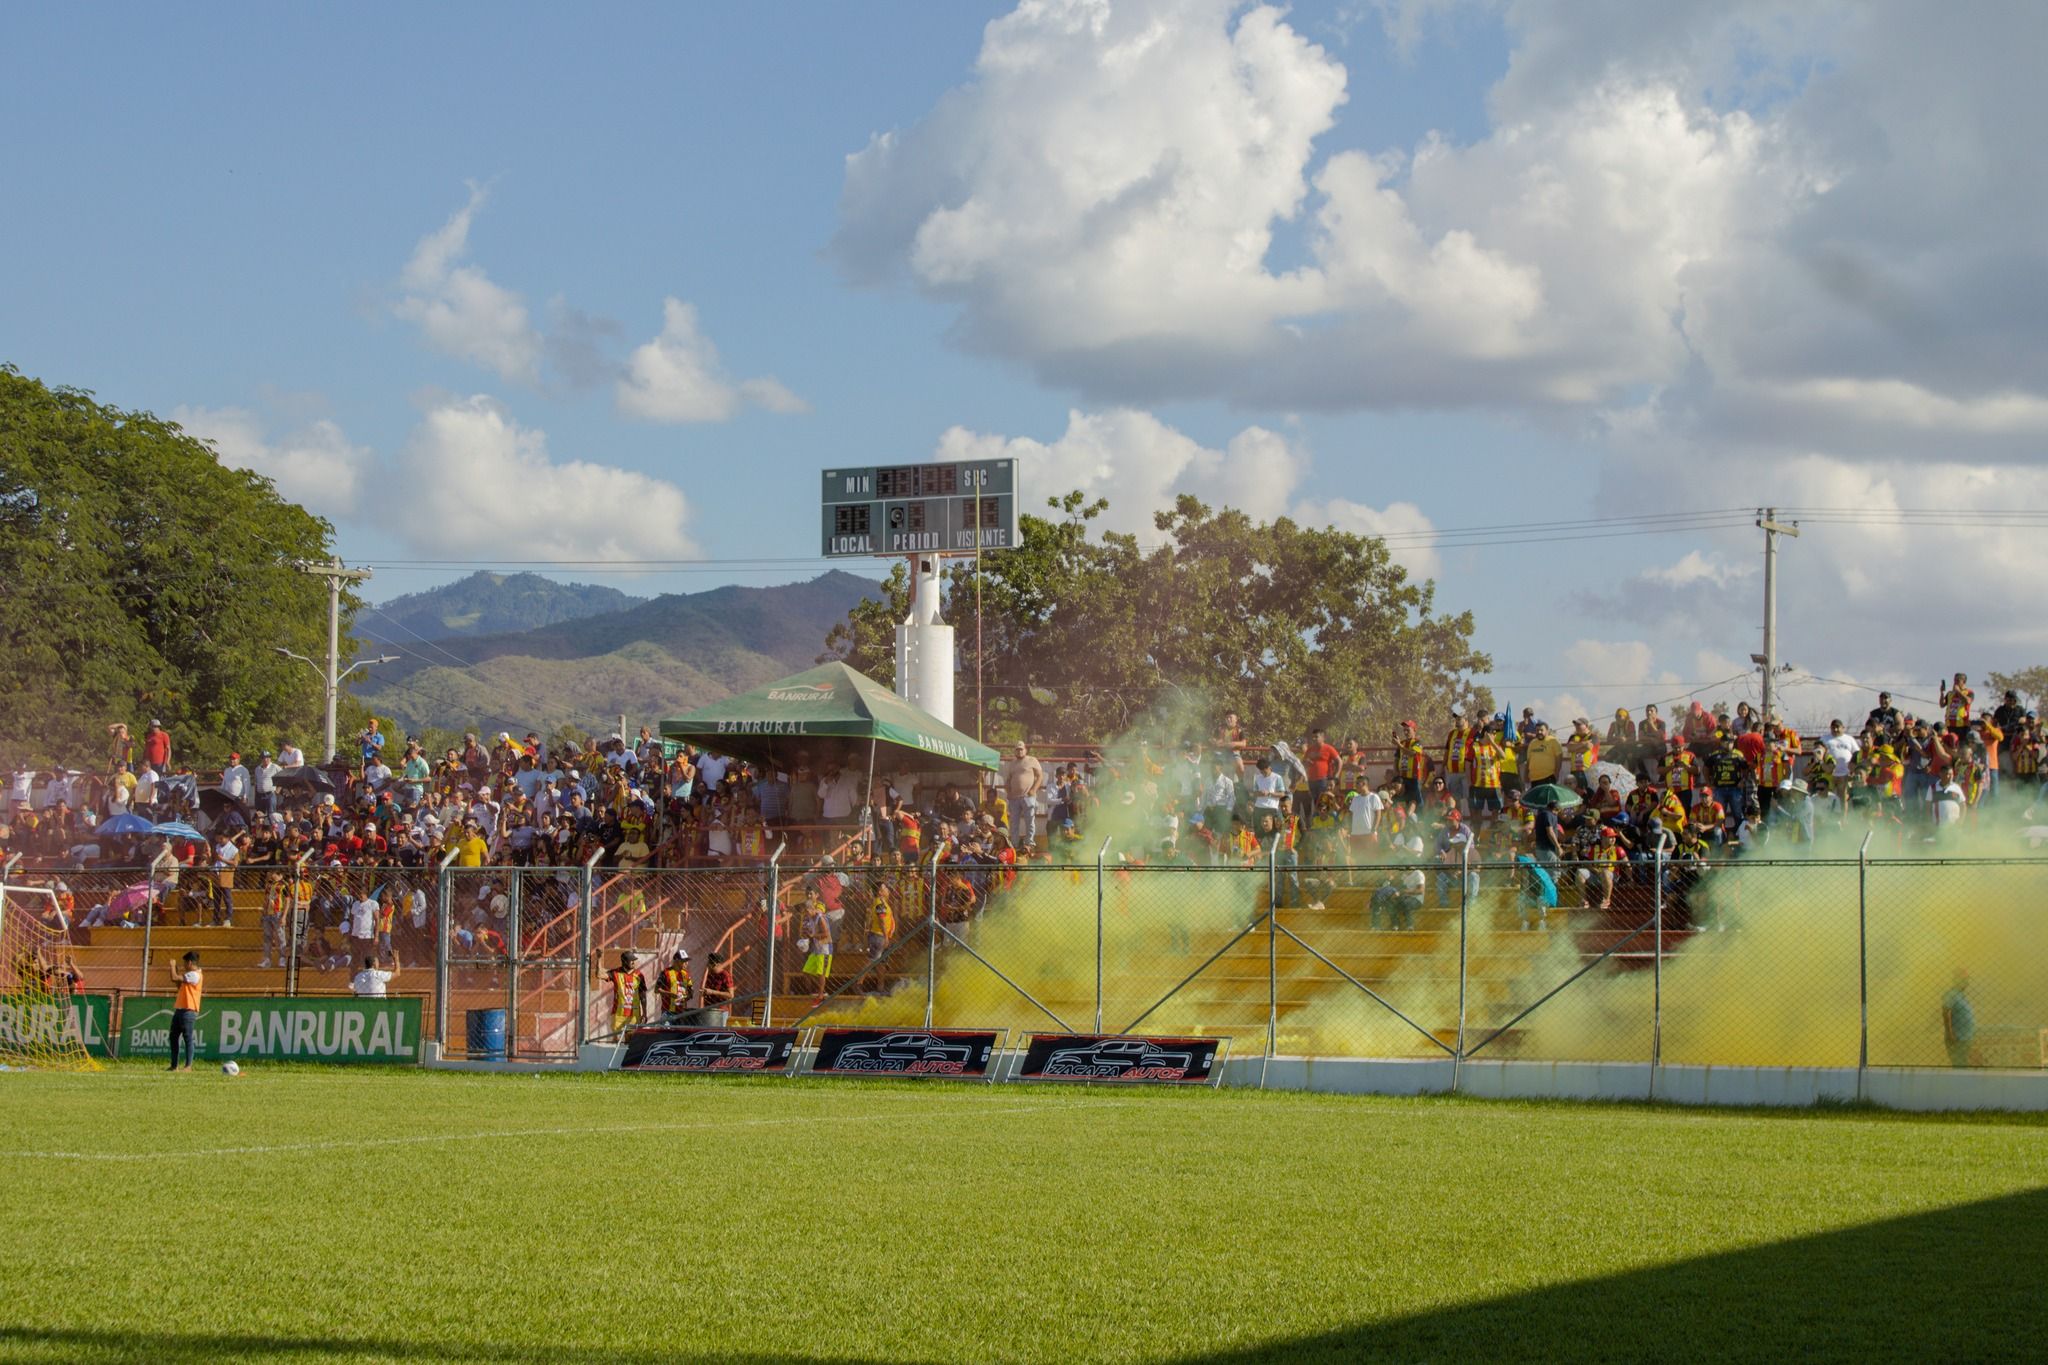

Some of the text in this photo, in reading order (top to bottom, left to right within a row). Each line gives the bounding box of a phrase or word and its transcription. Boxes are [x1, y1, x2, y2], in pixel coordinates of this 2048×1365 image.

[846, 476, 870, 493] MIN
[832, 535, 873, 553] LOCAL
[893, 532, 939, 550] PERIOD
[956, 528, 1005, 548] VISIANTE
[767, 691, 835, 701] BANRURAL
[717, 720, 807, 734] BANRURAL
[918, 734, 969, 761] BANRURAL
[131, 1029, 207, 1047] BANRAL
[219, 1010, 414, 1056] BANRURAL
[645, 1056, 769, 1069] ZACAPA AUTOS
[839, 1058, 967, 1073] ZACAPA AUTOS
[1048, 1064, 1189, 1079] ZACAPA AUTOS
